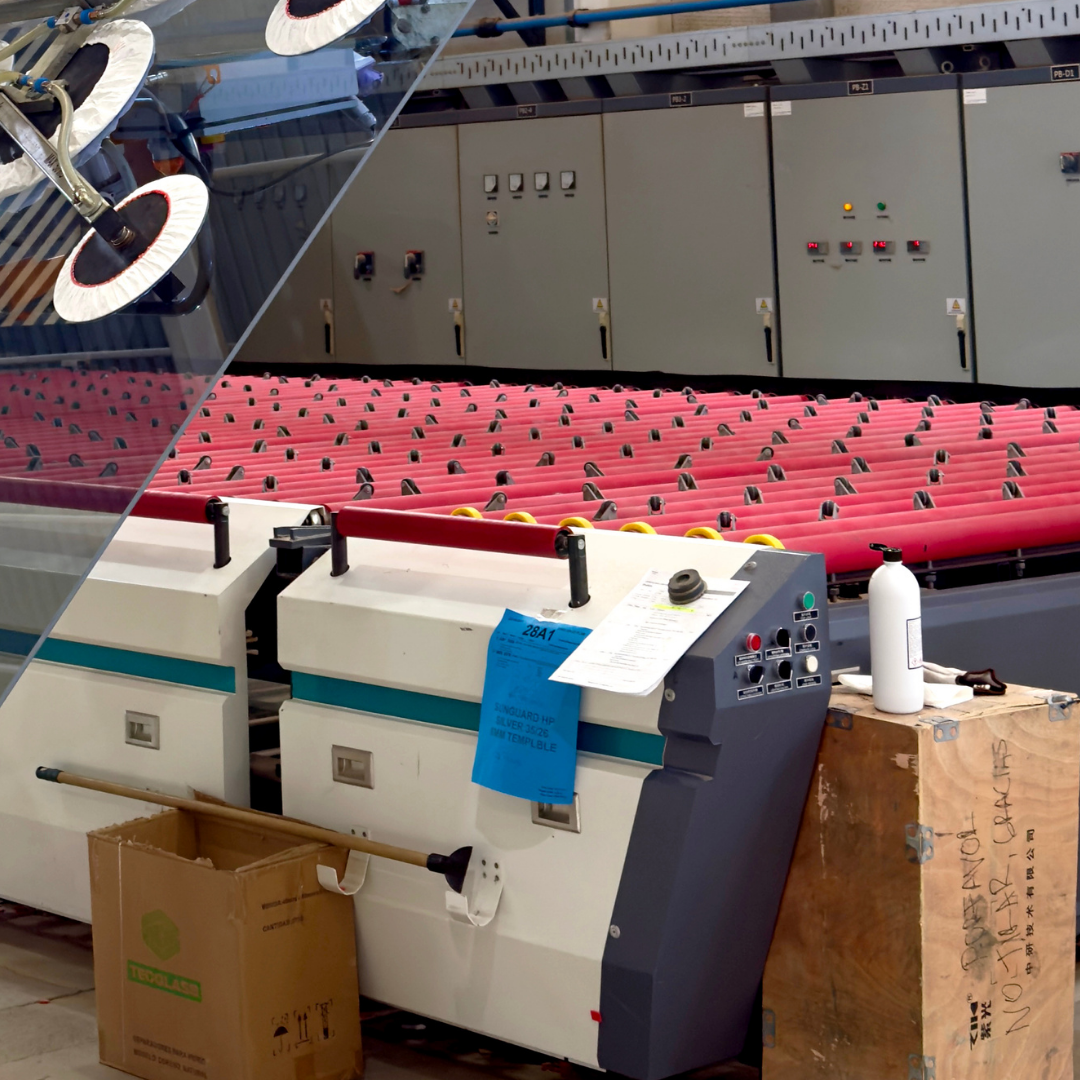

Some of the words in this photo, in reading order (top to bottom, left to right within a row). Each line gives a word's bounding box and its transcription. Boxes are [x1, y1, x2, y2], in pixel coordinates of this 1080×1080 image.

[522, 624, 556, 641] 28A1
[496, 716, 523, 731] SILVER
[541, 714, 556, 726] HP
[992, 739, 1016, 844] GRACIAS
[1001, 983, 1031, 1036] NO
